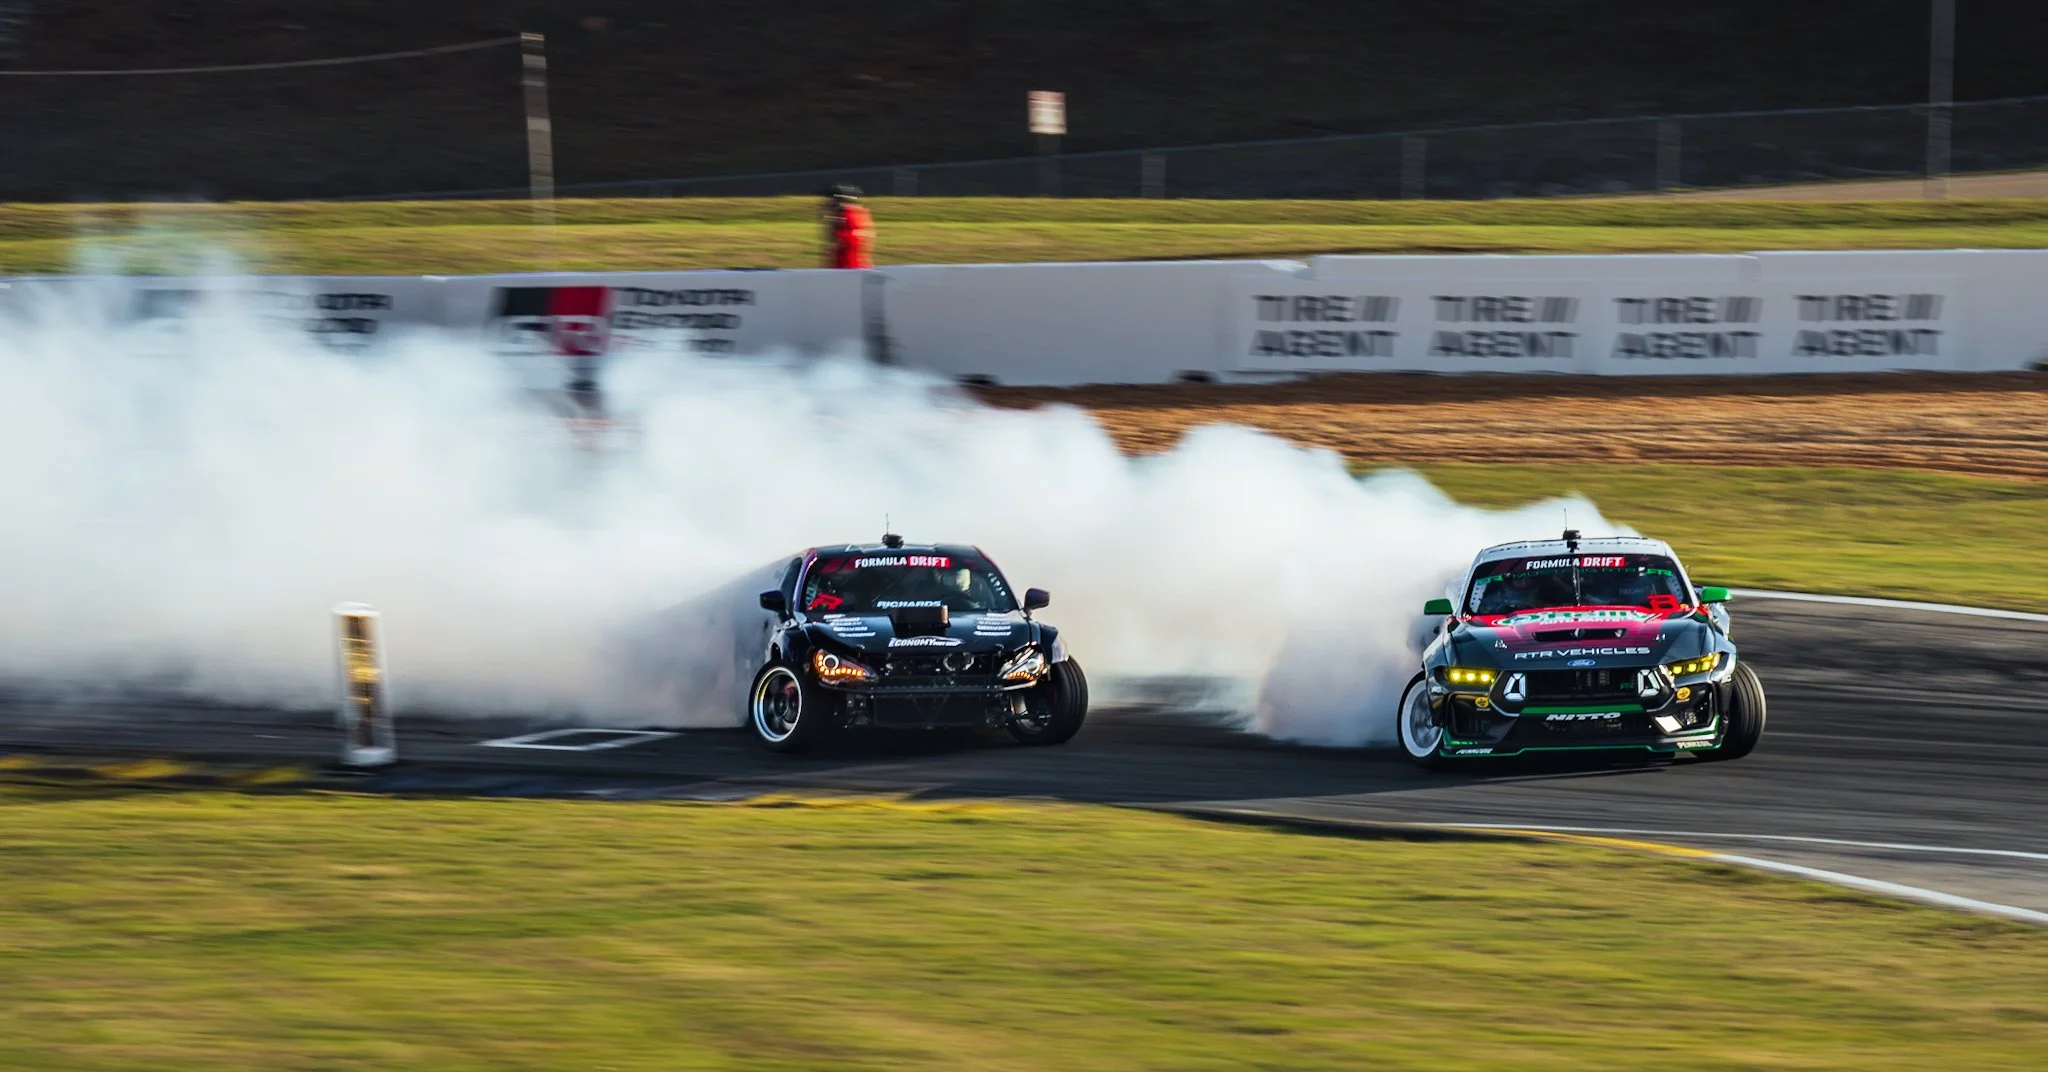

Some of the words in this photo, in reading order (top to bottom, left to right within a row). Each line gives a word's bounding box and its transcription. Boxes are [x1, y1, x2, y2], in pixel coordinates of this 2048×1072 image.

[1249, 329, 1402, 357] AGENT
[1427, 330, 1581, 358] AGENT
[1610, 331, 1763, 358] AGENT
[1791, 328, 1944, 356] AGENT
[855, 556, 908, 568] FORMULA
[909, 555, 948, 567] DRIFT
[1526, 557, 1580, 570] FORMULA
[1583, 556, 1622, 567] DRIFT
[876, 600, 941, 609] RICHARDS
[888, 637, 936, 647] ECONOMY
[1514, 651, 1553, 660] RTR
[1556, 647, 1651, 657] VEHICLES
[1545, 712, 1622, 721] NITTO
